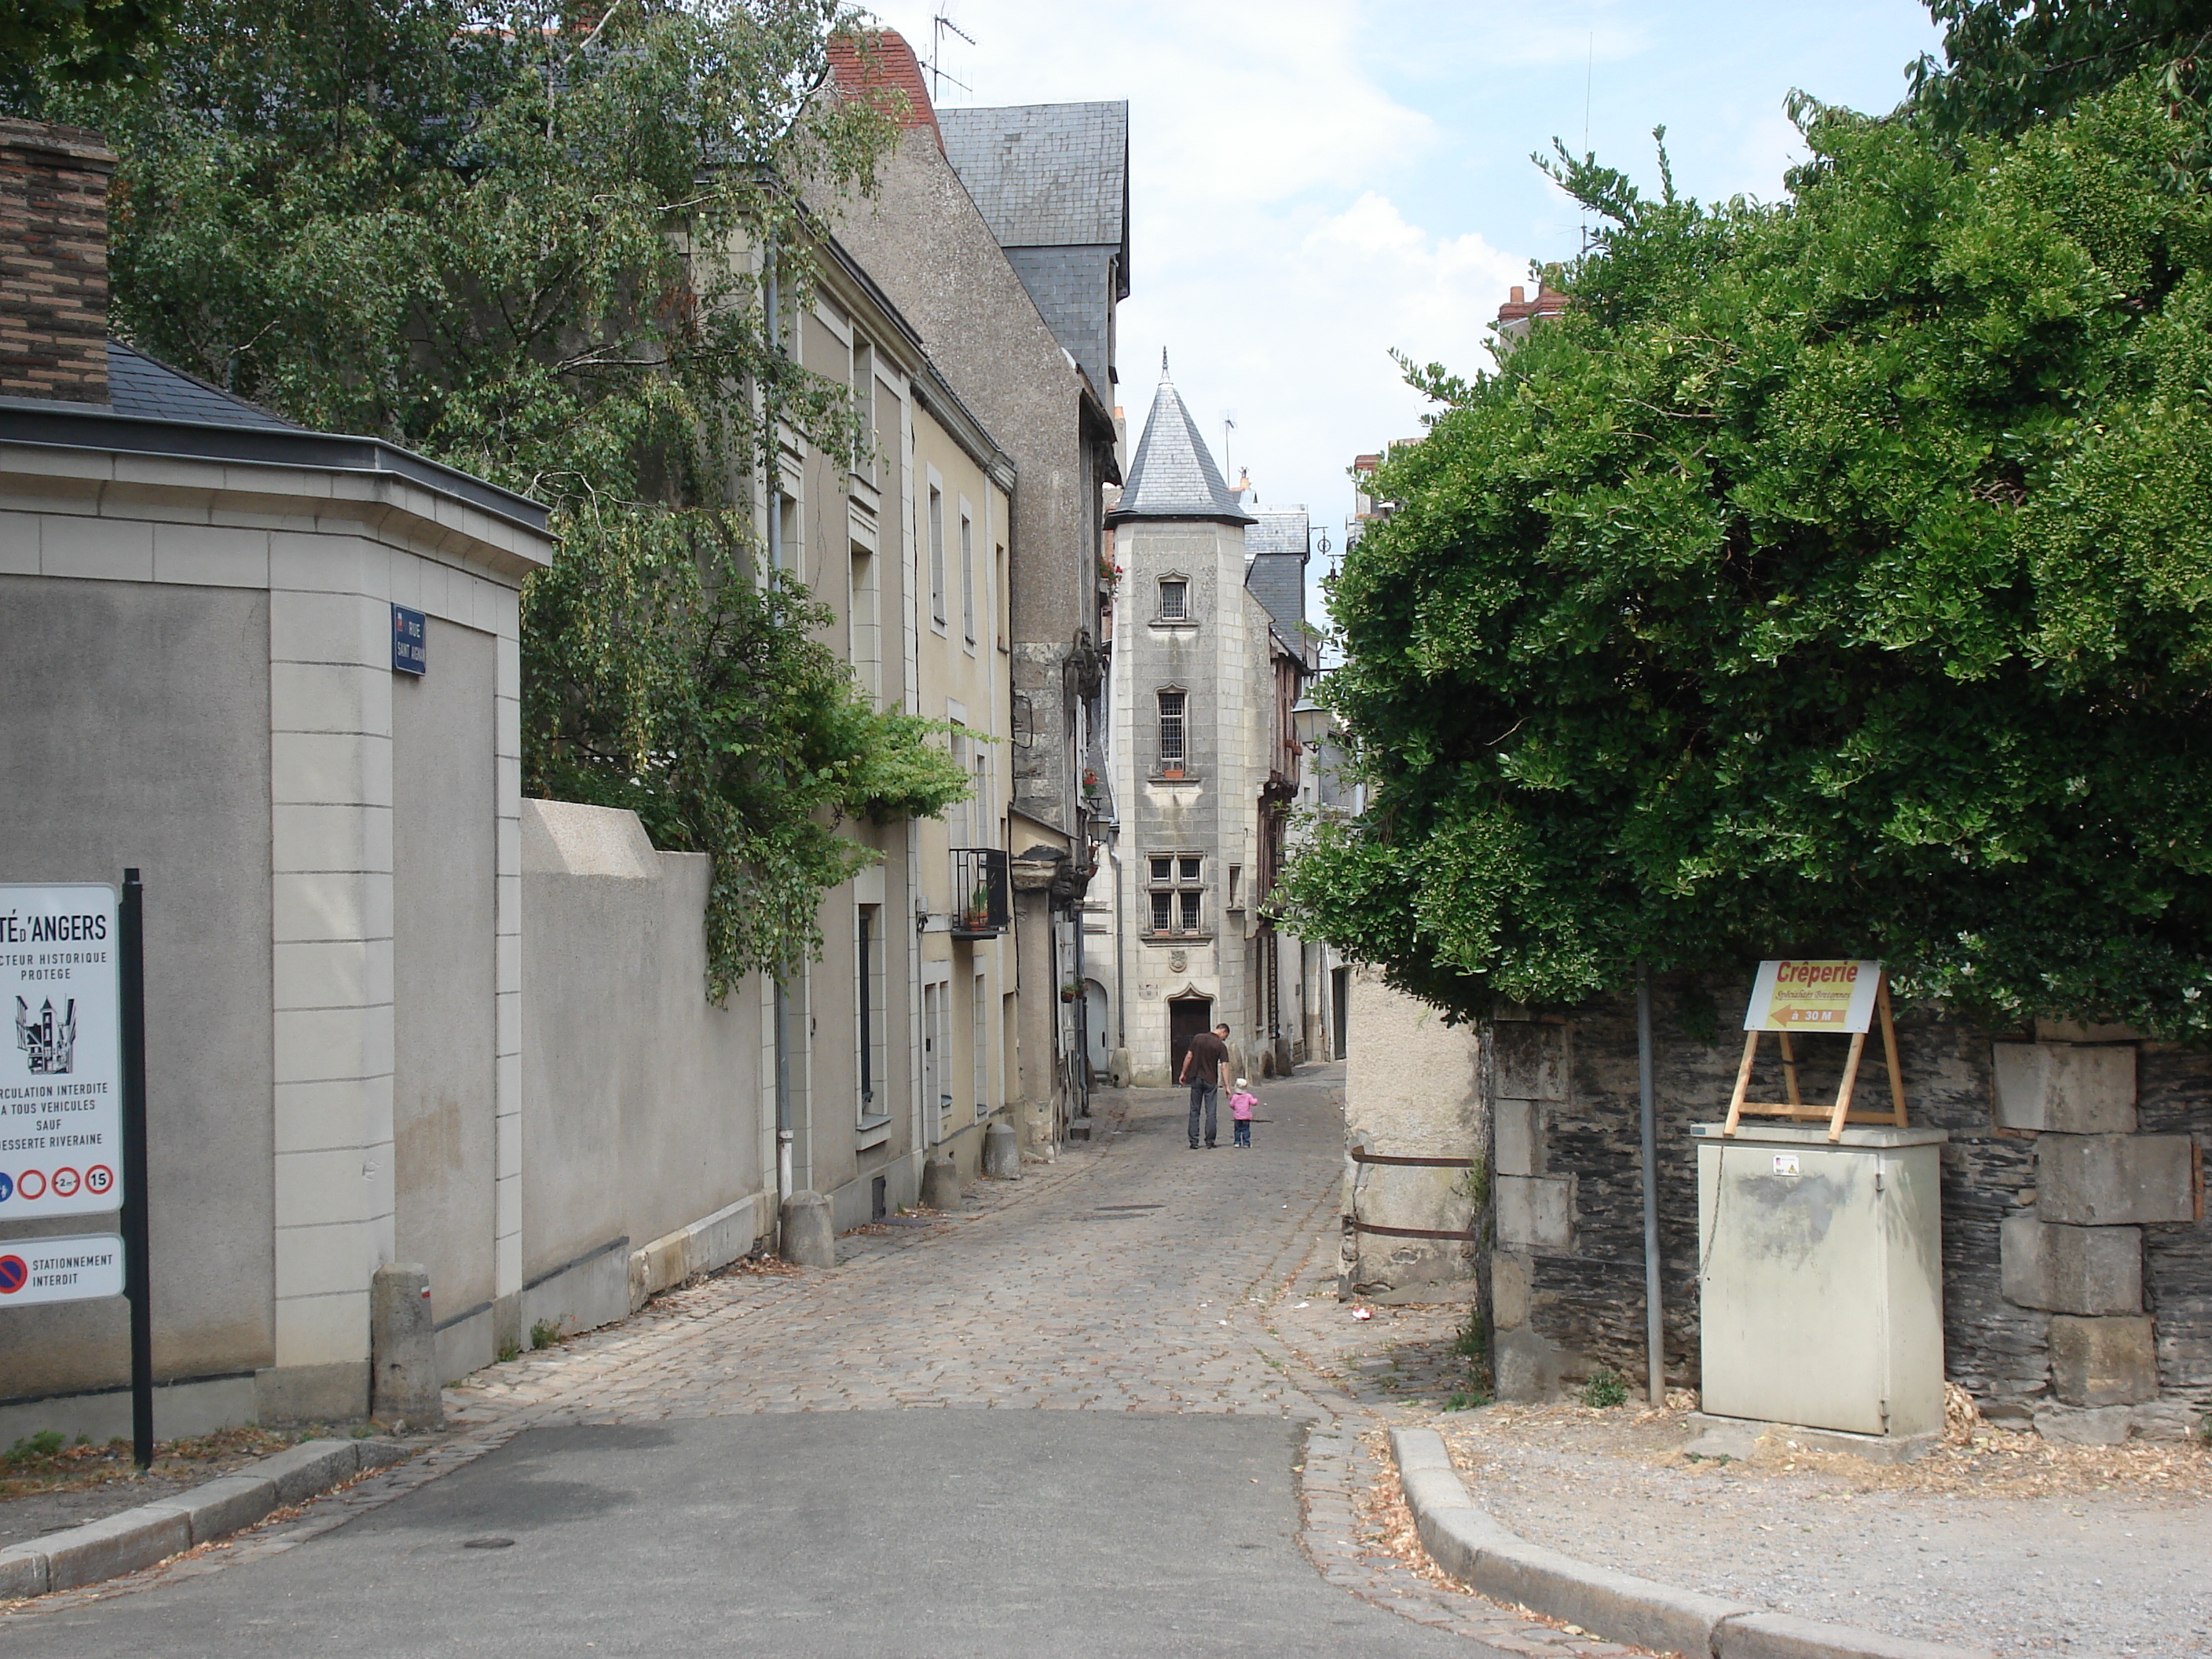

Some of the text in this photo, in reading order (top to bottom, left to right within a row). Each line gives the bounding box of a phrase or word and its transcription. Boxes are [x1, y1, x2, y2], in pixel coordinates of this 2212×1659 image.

[39, 952, 107, 965] HISTORIQUE
[21, 969, 71, 980] PROTEGE
[1777, 961, 1859, 987] Crêperie
[1792, 1011, 1832, 1020] à 30 M
[57, 1082, 108, 1096] INTERDITE
[1, 1100, 95, 1115] A TOUS VEHICULES
[36, 1119, 61, 1131] SAUF
[0, 1133, 102, 1151] ESSERTE RIVERAINE
[90, 1173, 106, 1186] 15
[33, 1254, 113, 1271] STATIONNEMENT
[33, 1273, 78, 1287] INTERDIT
